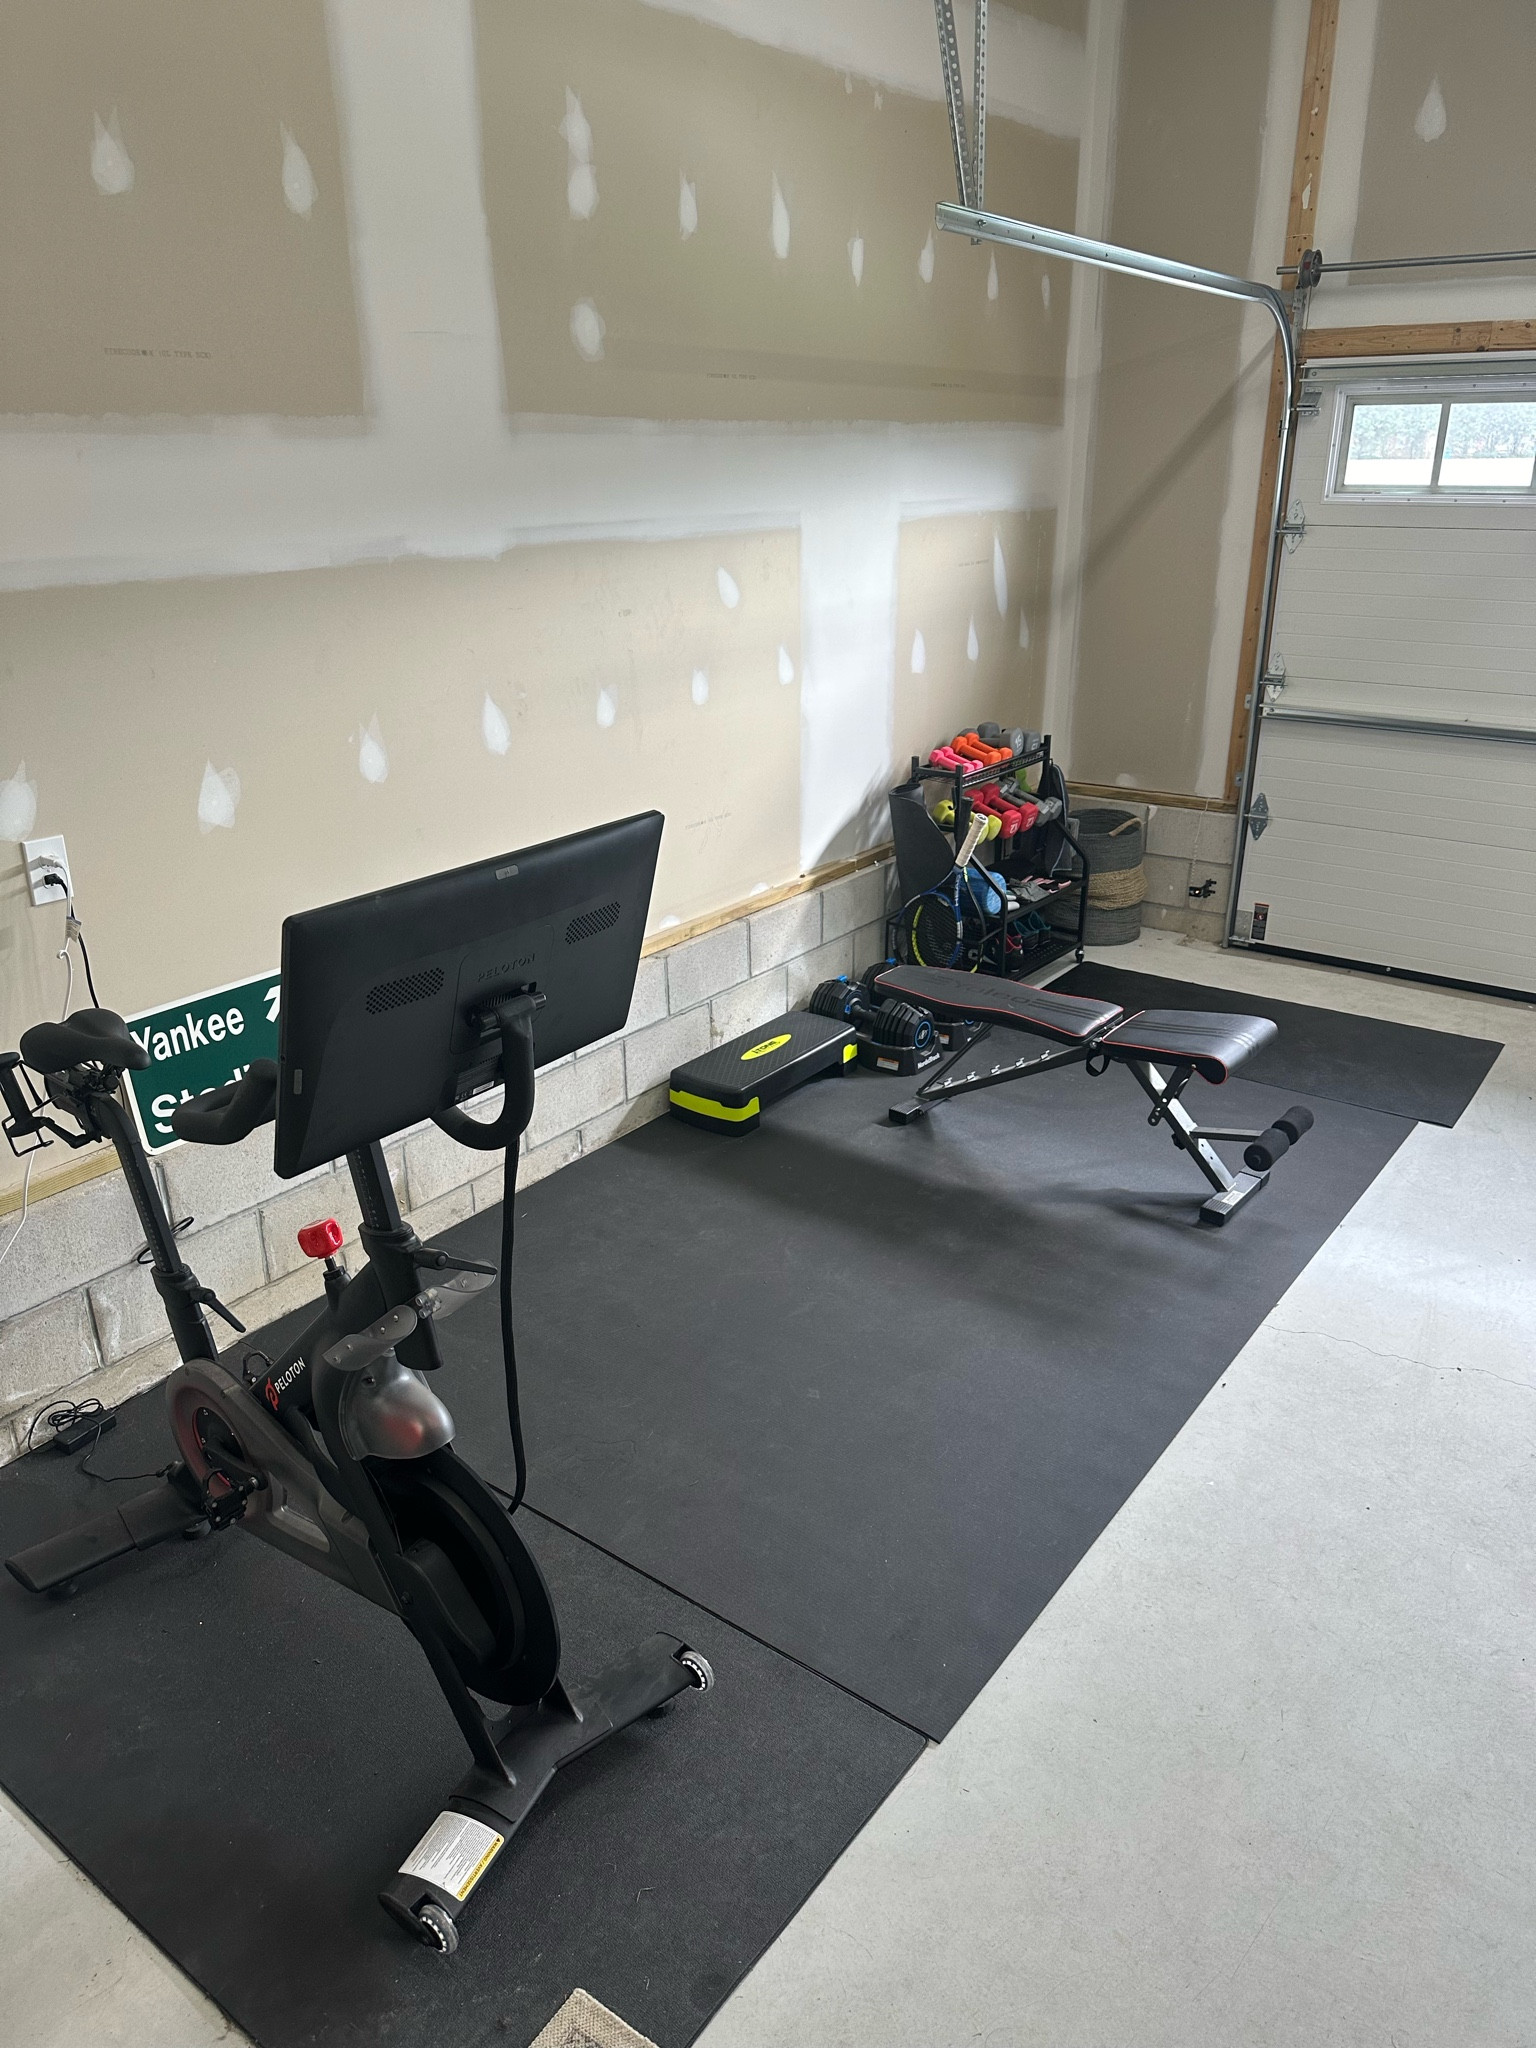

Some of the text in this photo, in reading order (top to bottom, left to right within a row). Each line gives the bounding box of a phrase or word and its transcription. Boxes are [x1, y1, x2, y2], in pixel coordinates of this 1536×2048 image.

[478, 953, 536, 982] PELOTON
[130, 1007, 245, 1061] Yankee
[274, 1357, 306, 1393] PELOTON
